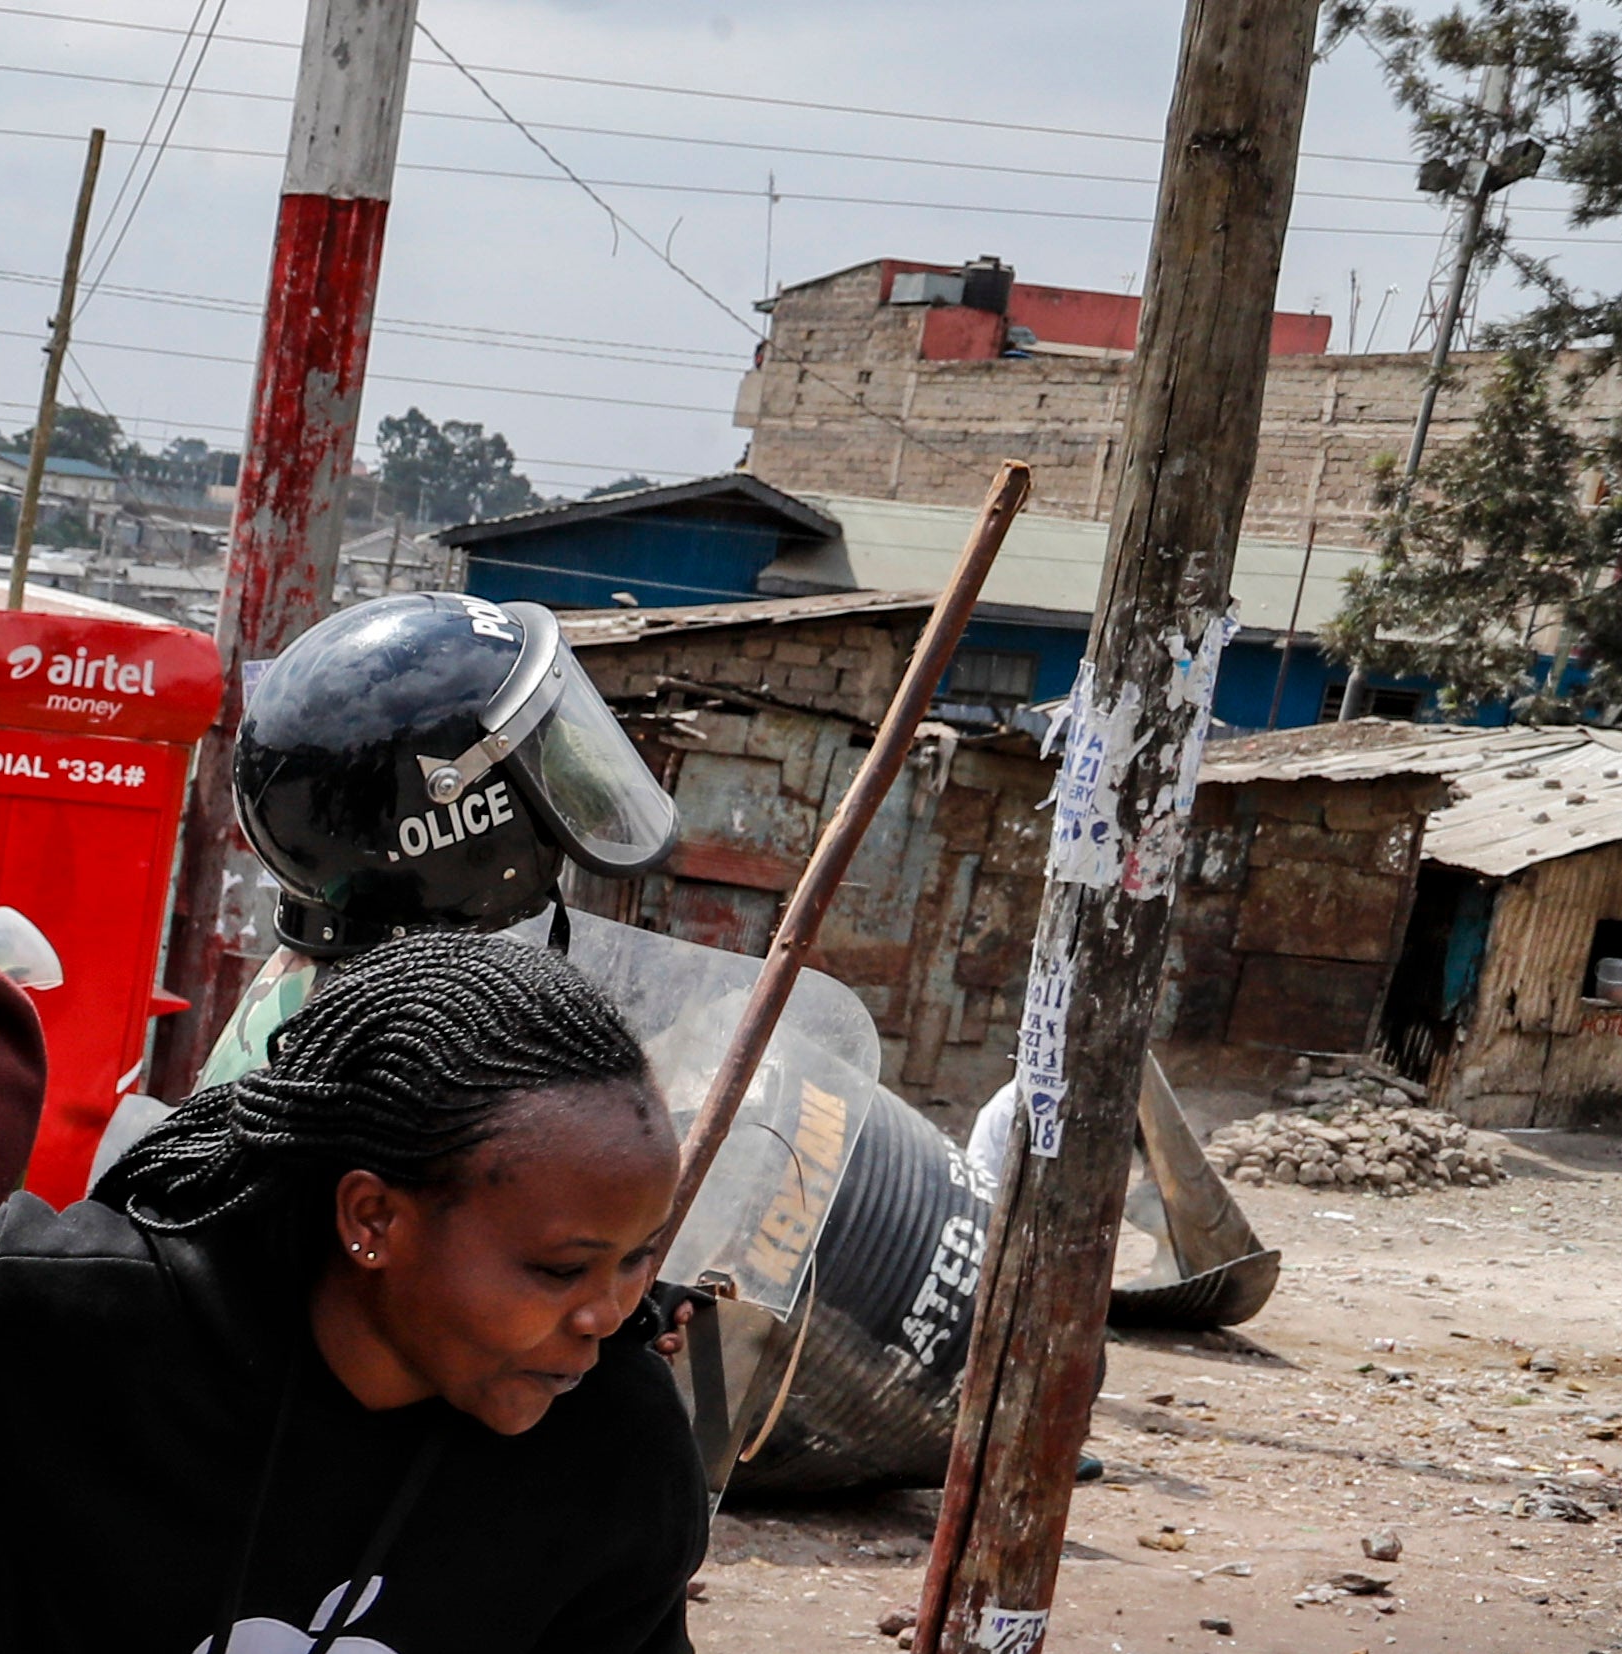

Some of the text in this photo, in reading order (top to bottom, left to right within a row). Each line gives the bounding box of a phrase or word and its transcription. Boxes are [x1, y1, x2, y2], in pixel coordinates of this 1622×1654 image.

[47, 646, 155, 696] airtel
[47, 694, 123, 720] money
[387, 781, 514, 862] OLICE
